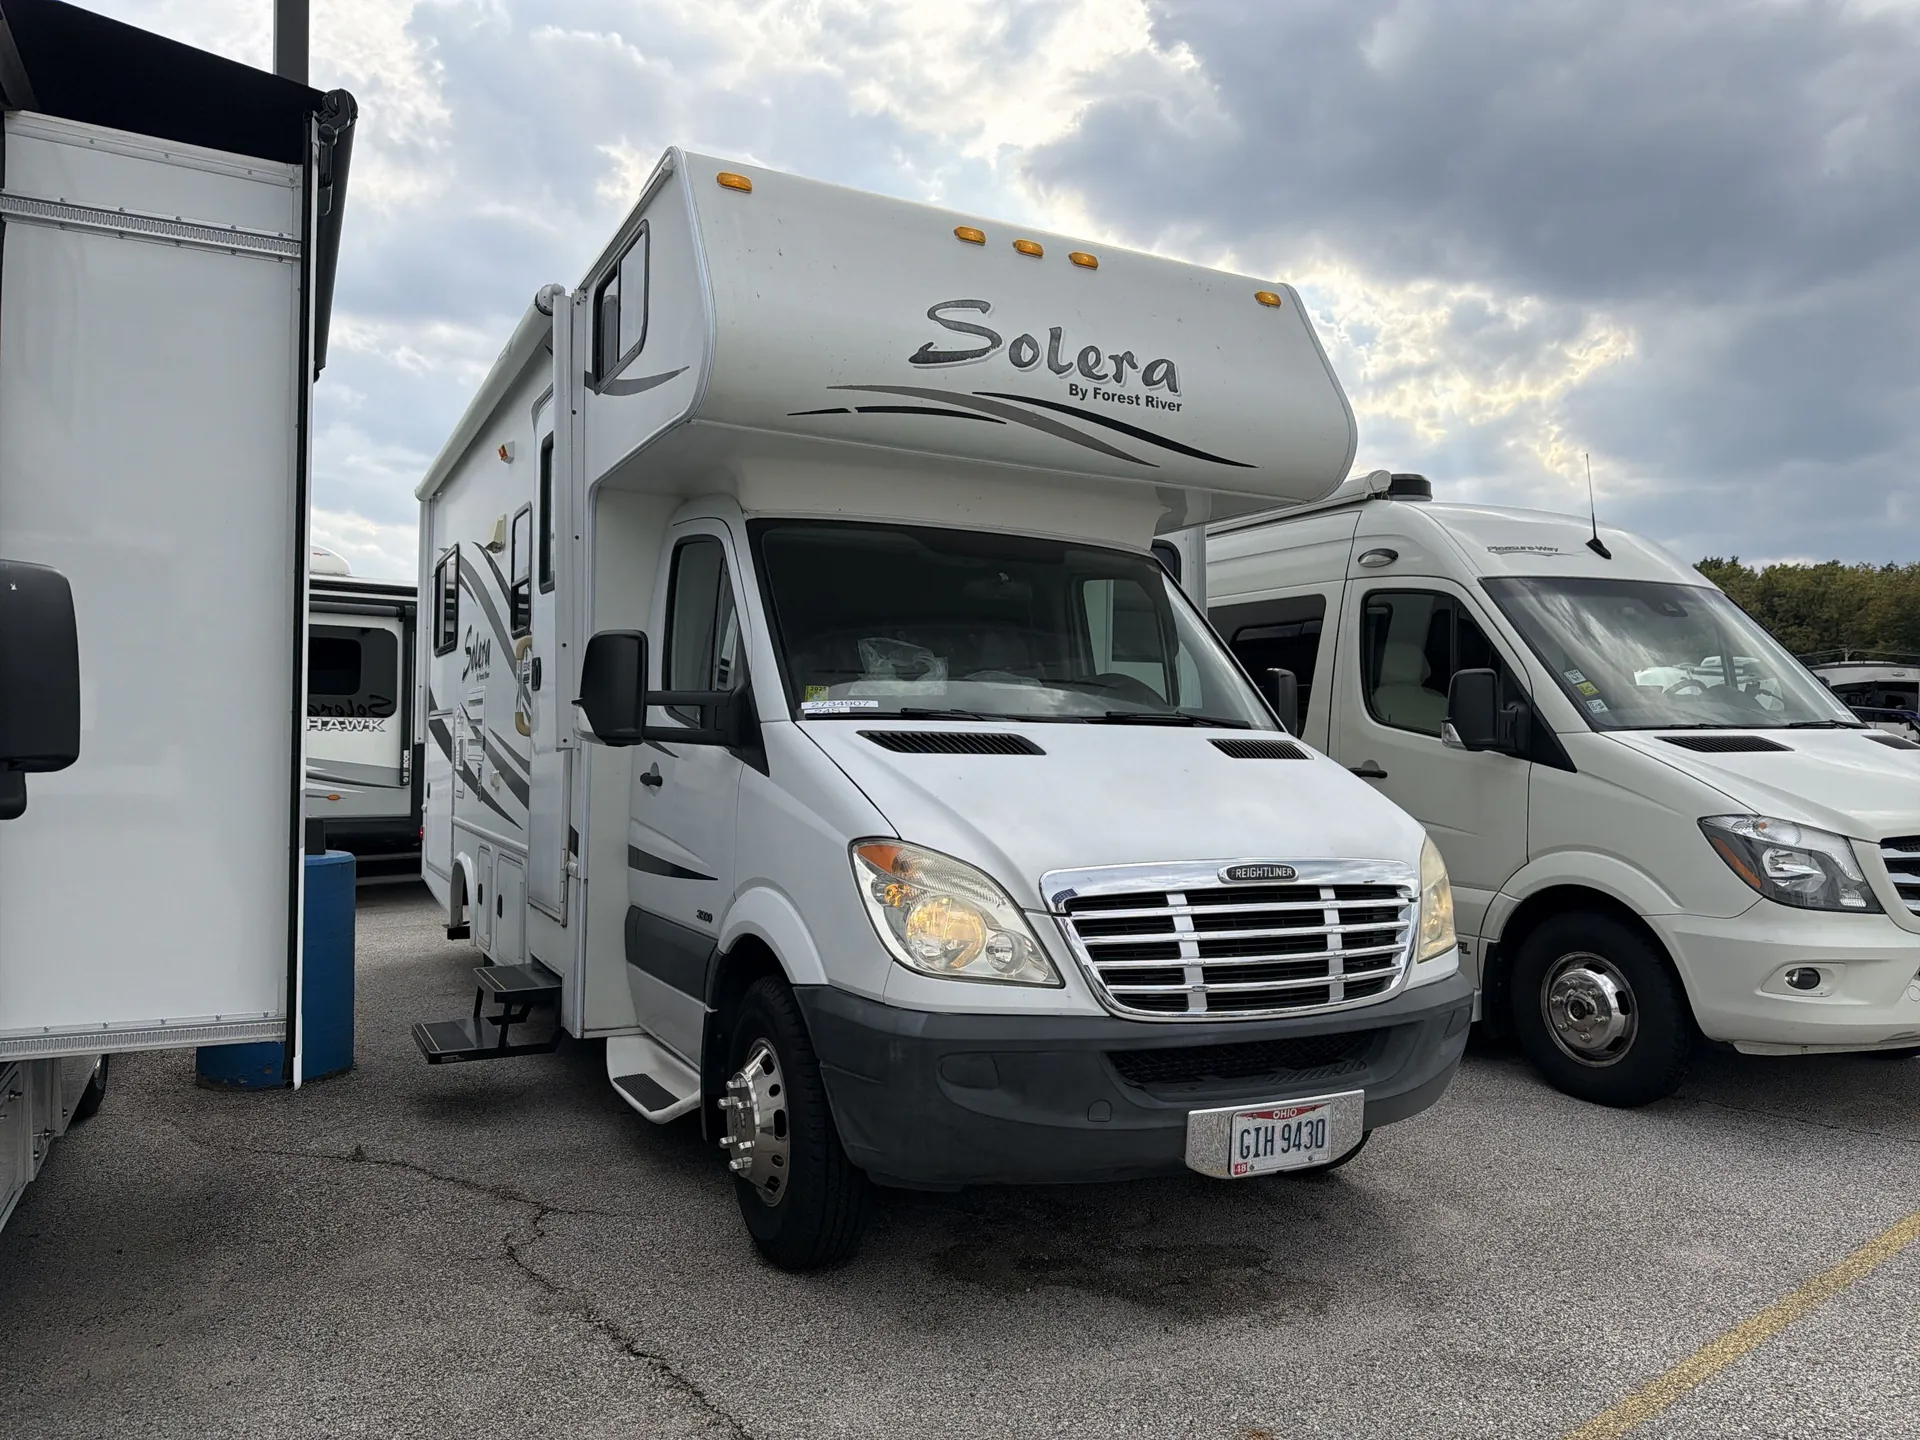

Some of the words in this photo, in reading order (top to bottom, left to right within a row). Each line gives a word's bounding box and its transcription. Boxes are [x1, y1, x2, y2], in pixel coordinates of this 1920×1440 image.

[908, 299, 1181, 396] Solera
[1068, 383, 1088, 401] By
[1093, 387, 1141, 406] Forest
[1145, 395, 1182, 412] River
[1231, 866, 1293, 878] FREIGHTLINER
[1272, 1108, 1298, 1120] OHIO
[1240, 1125, 1275, 1160] GIH
[1281, 1118, 1326, 1154] 9430
